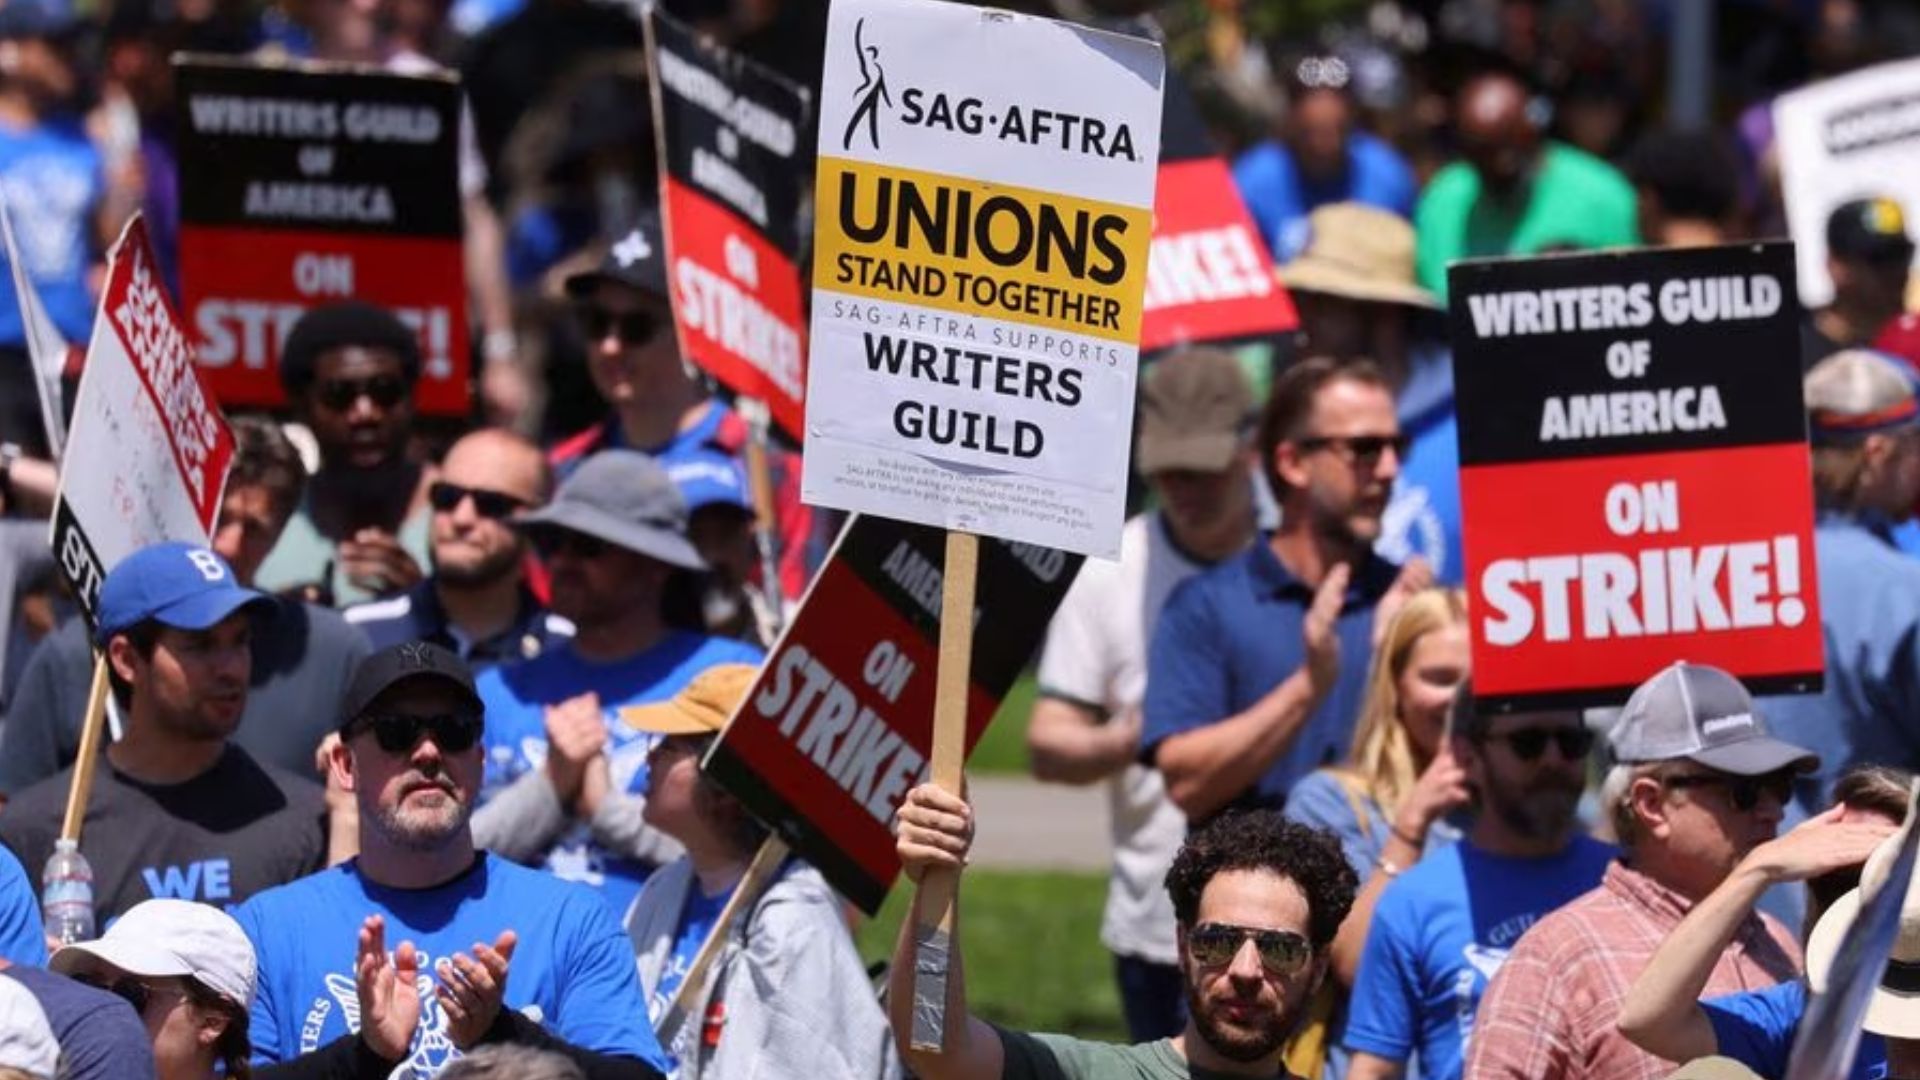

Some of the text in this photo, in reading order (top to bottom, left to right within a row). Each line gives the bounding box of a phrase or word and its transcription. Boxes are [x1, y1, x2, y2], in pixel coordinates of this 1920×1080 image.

[245, 181, 395, 222] AMERICA
[840, 171, 1128, 285] UNIONS
[293, 252, 354, 296] ON
[837, 253, 1121, 331] STAND TOGETHER
[834, 301, 1118, 367] SAG-AFTRA SUPPORTS
[1468, 275, 1782, 338] WRITERS GUILD
[864, 332, 1083, 407] WRITERS
[1606, 340, 1651, 379] OF
[893, 400, 1044, 459] GUILD
[1540, 386, 1727, 441] AMERICA
[1605, 480, 1679, 536] ON
[185, 550, 225, 580] B
[1481, 534, 1806, 646] STRIKE!
[863, 640, 915, 703] ON
[755, 645, 931, 836] STRIKE
[142, 859, 231, 900] WE
